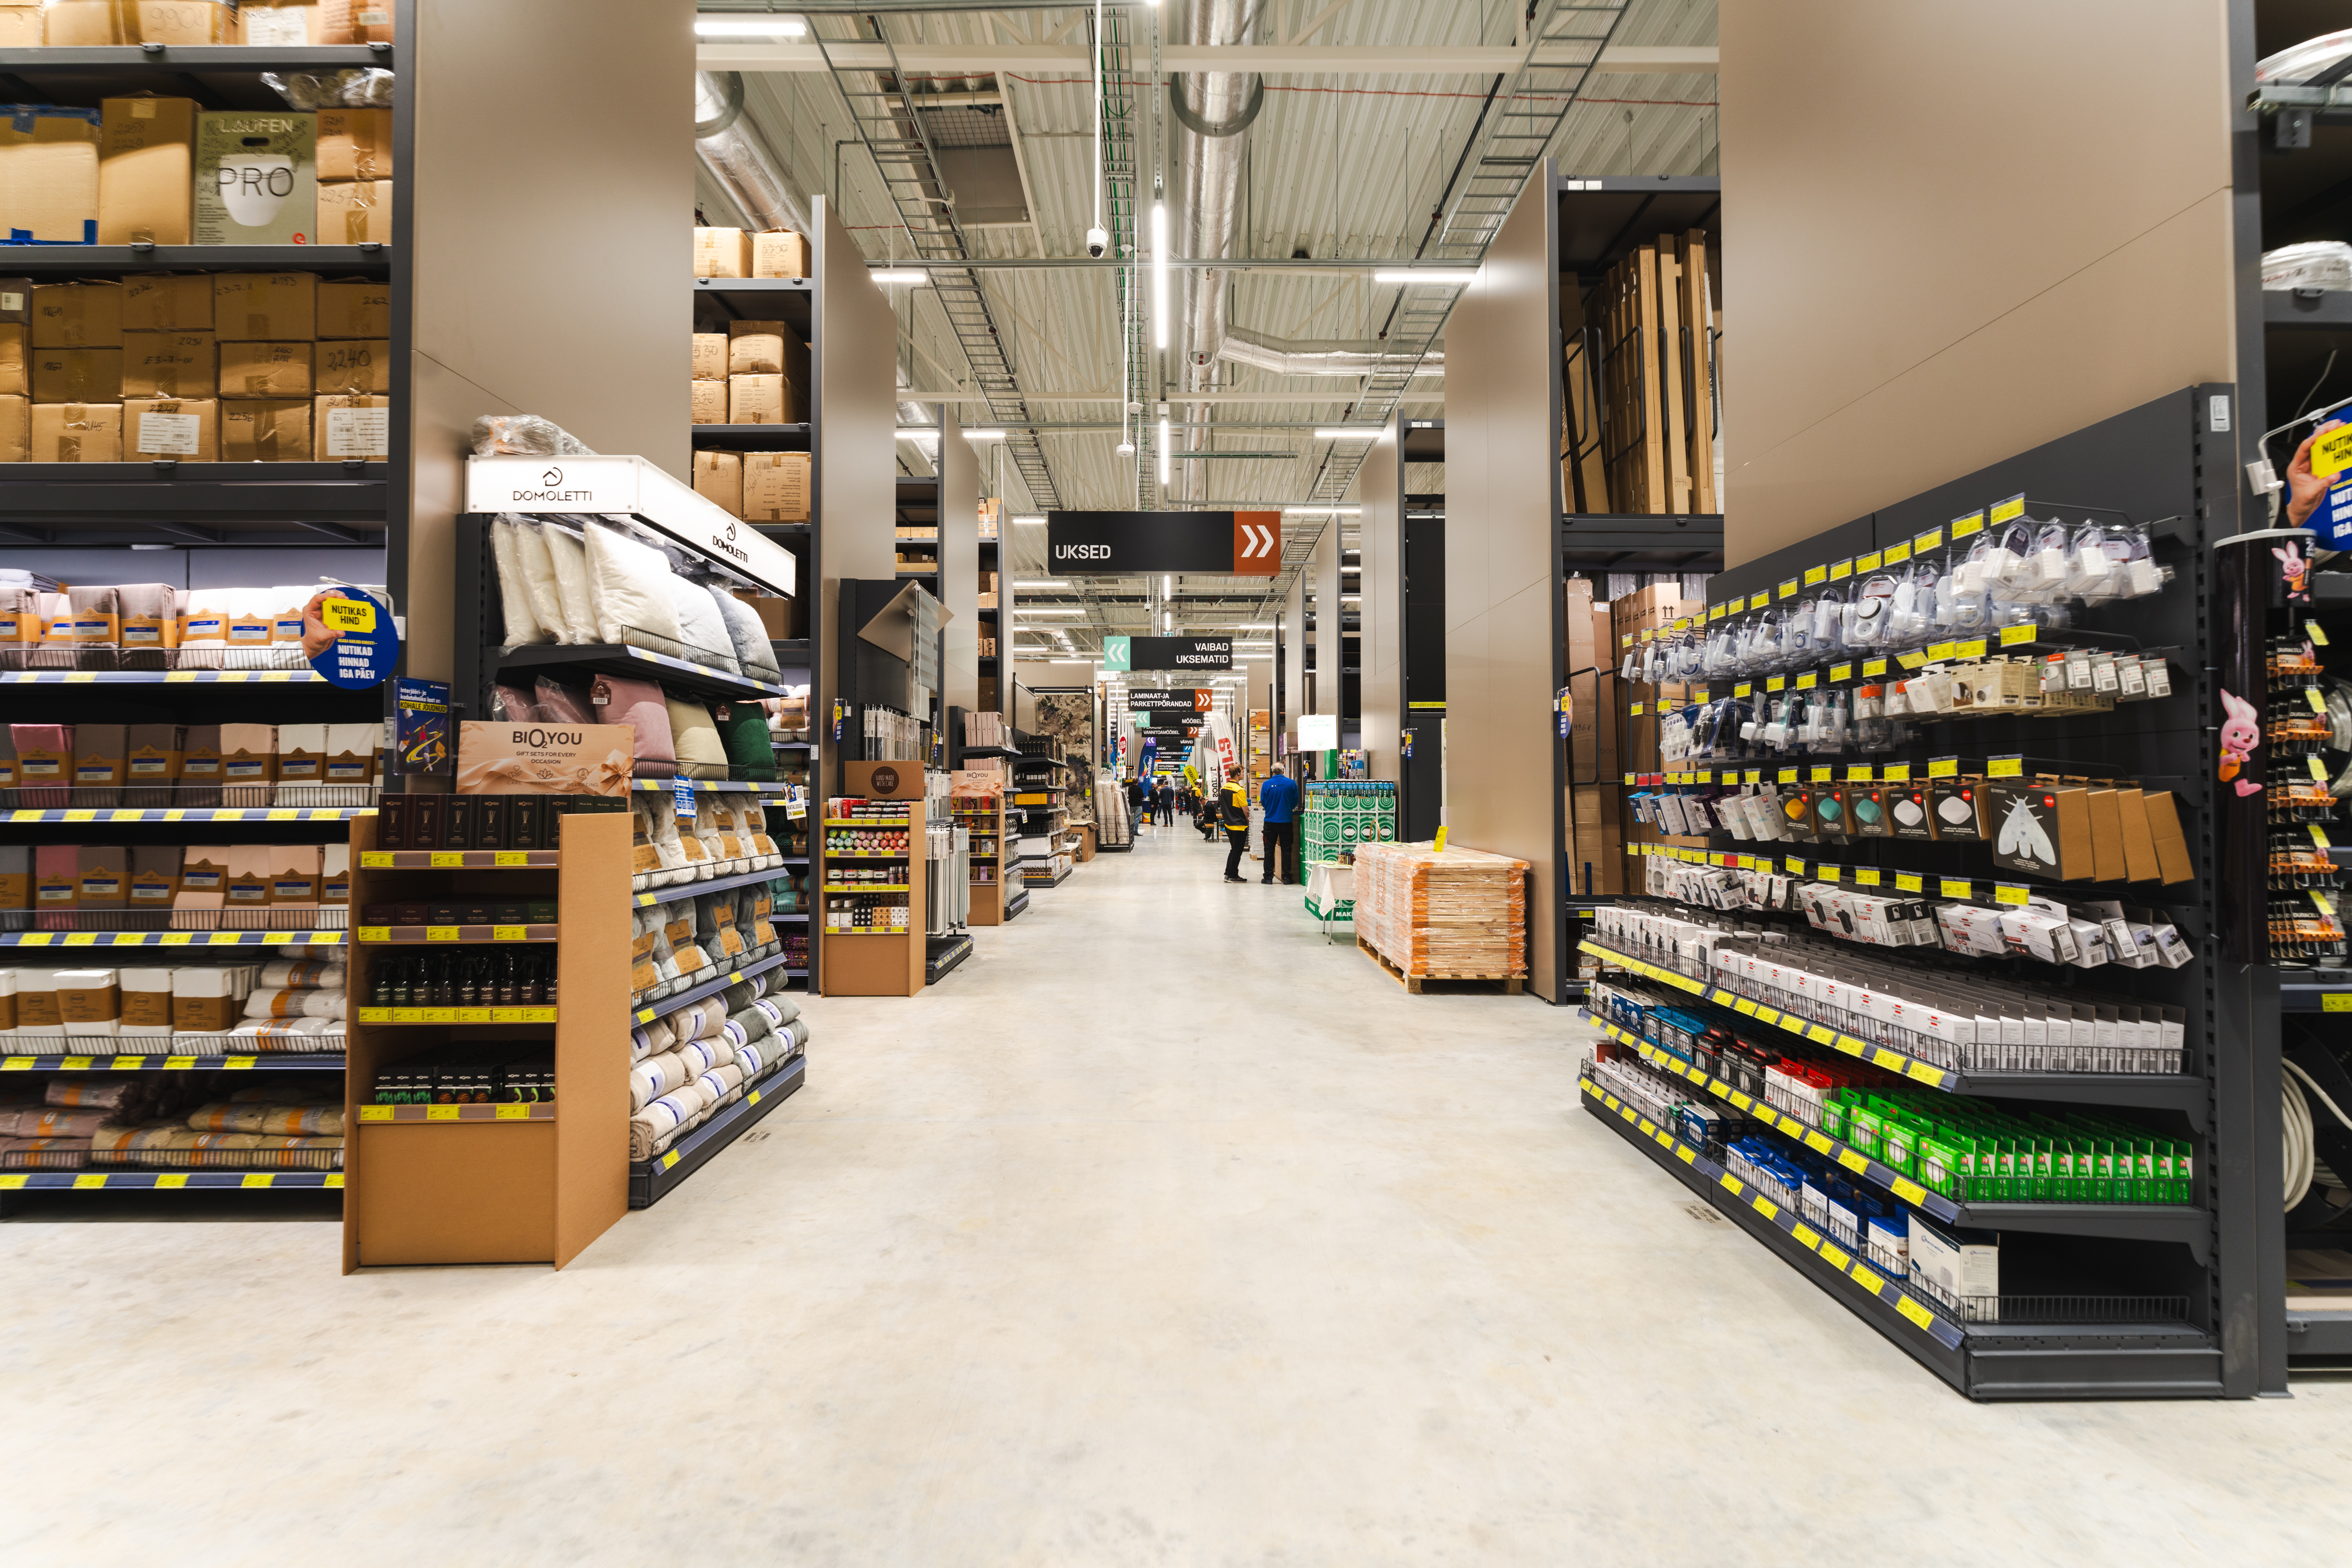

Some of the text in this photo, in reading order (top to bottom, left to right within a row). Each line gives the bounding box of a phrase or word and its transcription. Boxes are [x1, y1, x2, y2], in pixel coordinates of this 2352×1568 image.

[218, 166, 294, 197] PRO
[513, 490, 592, 501] DOMOLETTI
[2333, 522, 2352, 539] IGA
[713, 535, 748, 563] DOMOLETTI
[1055, 544, 1111, 560] UKSED
[332, 604, 367, 617] NUTIKAS
[340, 615, 360, 625] HIND
[337, 644, 373, 656] NUTIKAD
[1195, 643, 1229, 651] VAIBAD
[338, 657, 369, 667] HINNAD
[1176, 655, 1229, 664] UKSEMATID
[339, 667, 375, 679] IGA PÄEV
[400, 701, 422, 710] KOHALE
[1698, 1039, 1712, 1050] Smoke
[1723, 1048, 1739, 1061] Smoke
[1741, 1058, 1758, 1071] Smoke
